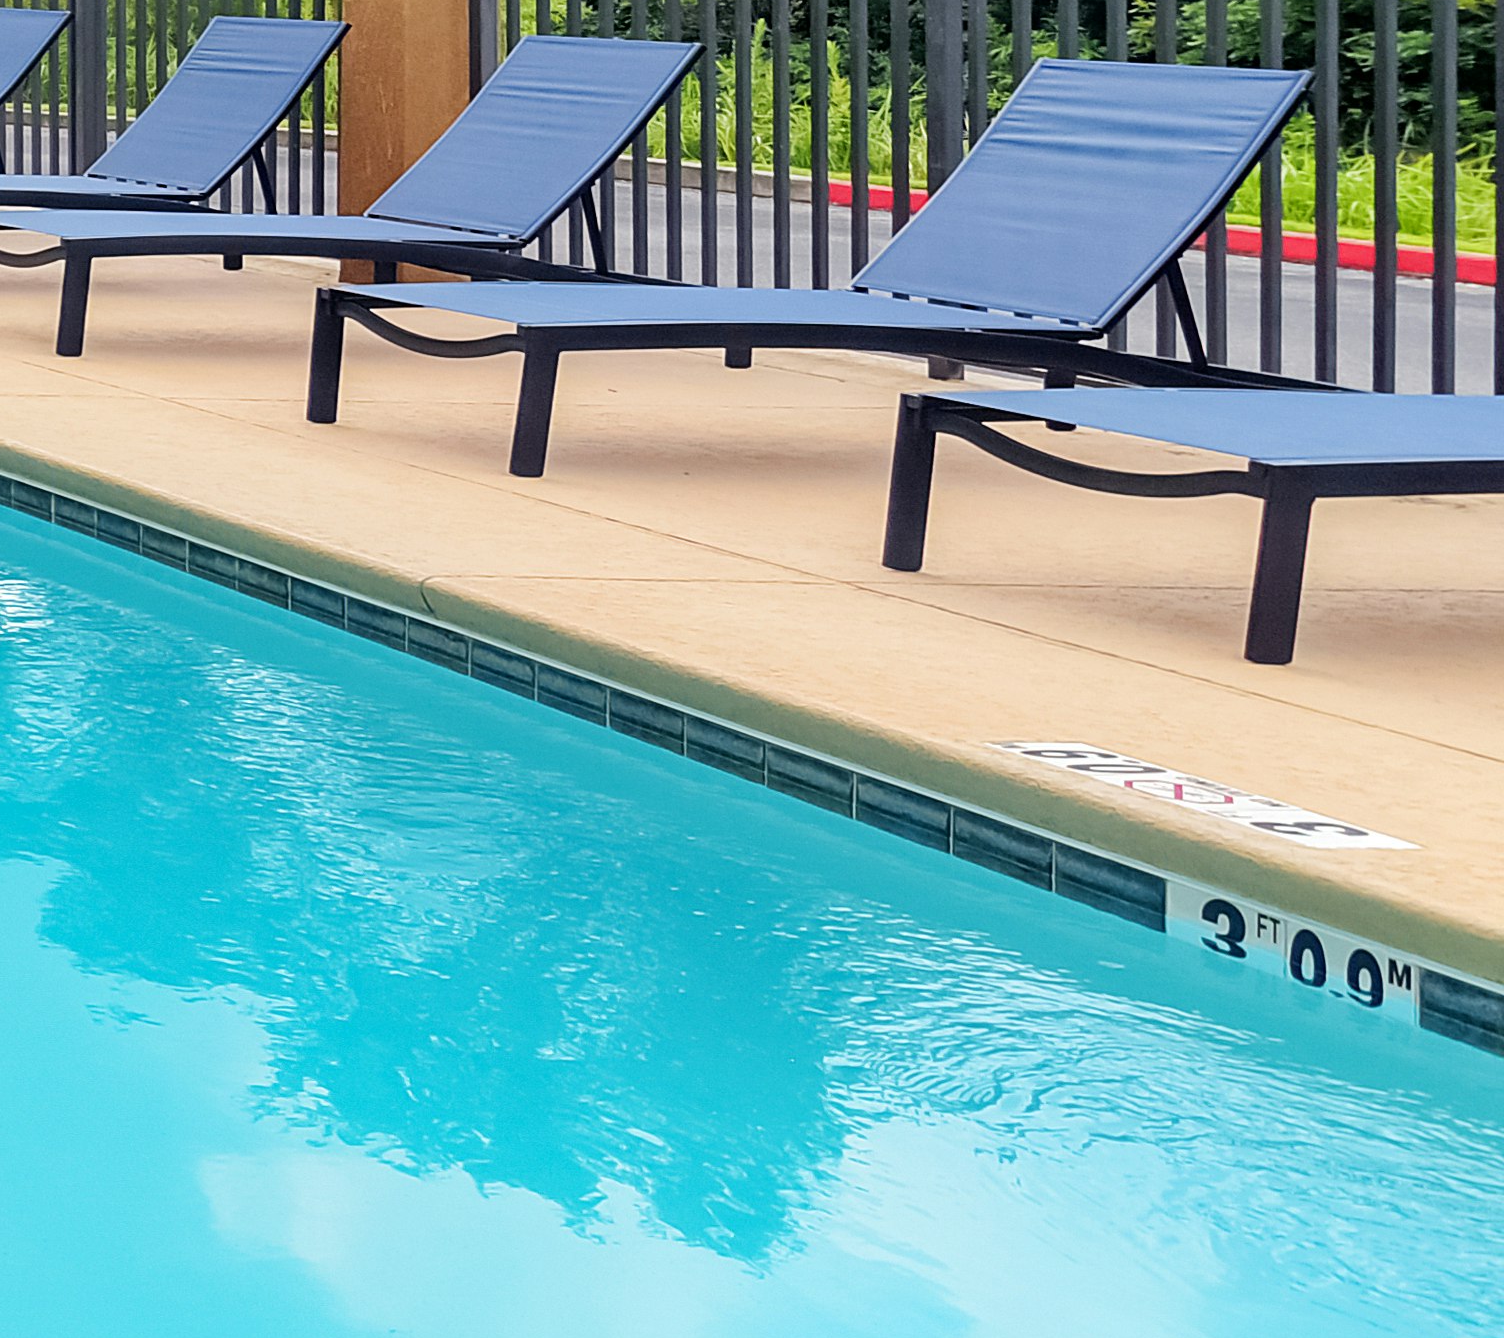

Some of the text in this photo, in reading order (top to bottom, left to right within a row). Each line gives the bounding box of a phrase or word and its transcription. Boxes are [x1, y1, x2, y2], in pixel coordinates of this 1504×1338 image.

[1201, 898, 1247, 959] 3
[1257, 912, 1280, 944] FT
[1388, 958, 1412, 991] M
